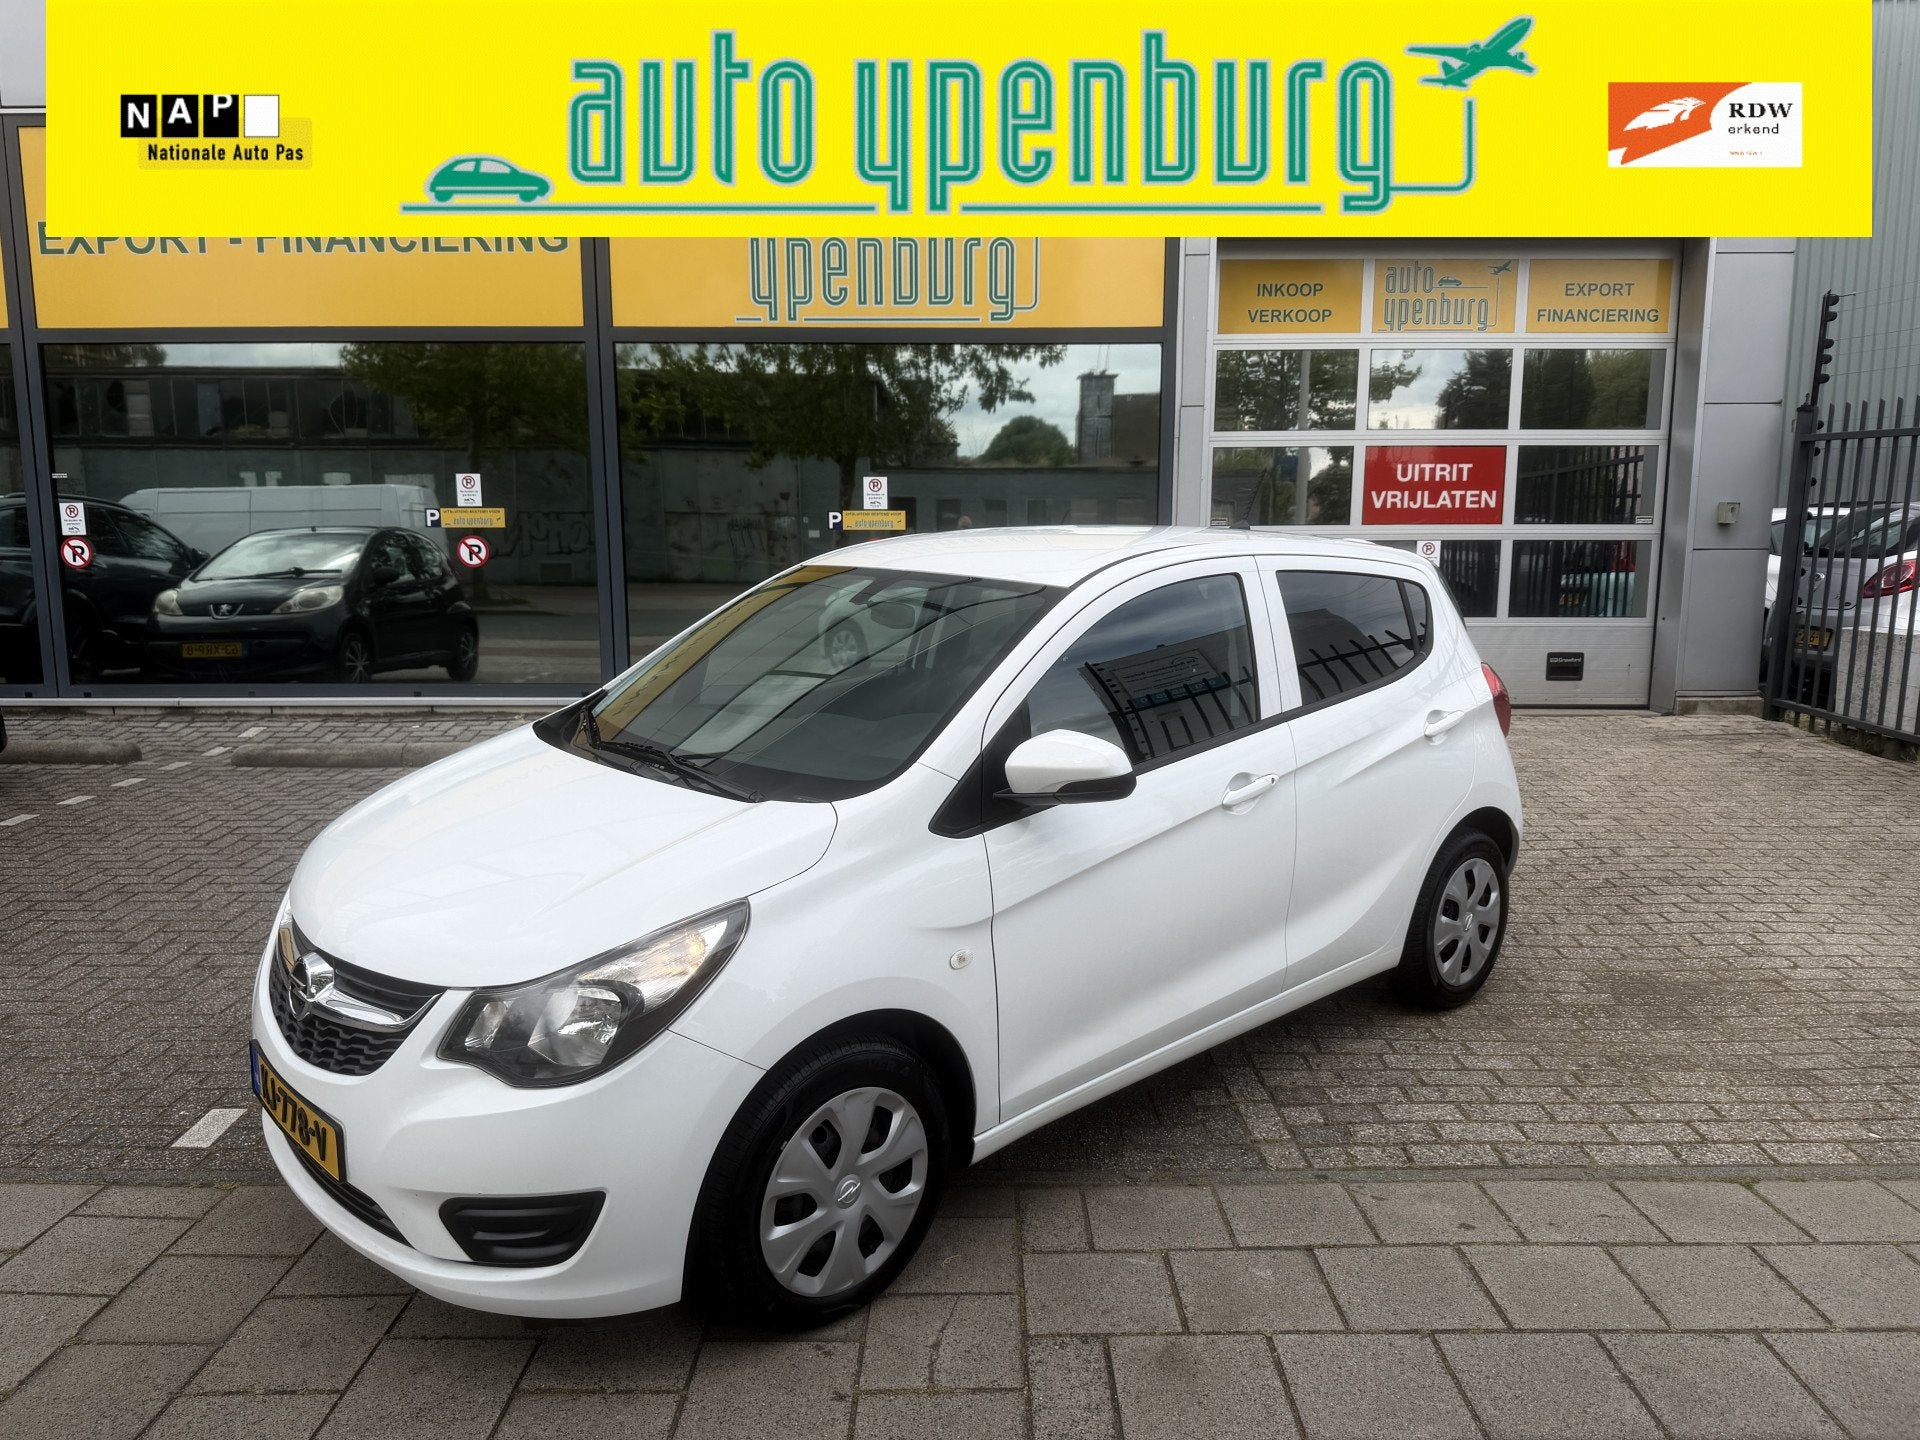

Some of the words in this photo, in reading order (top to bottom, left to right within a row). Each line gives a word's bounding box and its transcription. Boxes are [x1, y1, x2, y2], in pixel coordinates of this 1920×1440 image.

[748, 237, 1017, 322] ypenburg
[1385, 260, 1434, 293] auto
[1256, 282, 1324, 297] INKOOP
[1564, 282, 1635, 297] EXPORT
[1247, 308, 1332, 323] VERKOOP
[1384, 292, 1488, 332] ypenburg
[1536, 308, 1660, 323] FINANCIERING
[1396, 463, 1473, 482] UITRIT
[1371, 490, 1497, 509] VRIJLATEN
[425, 509, 440, 527] P
[828, 511, 842, 529] P
